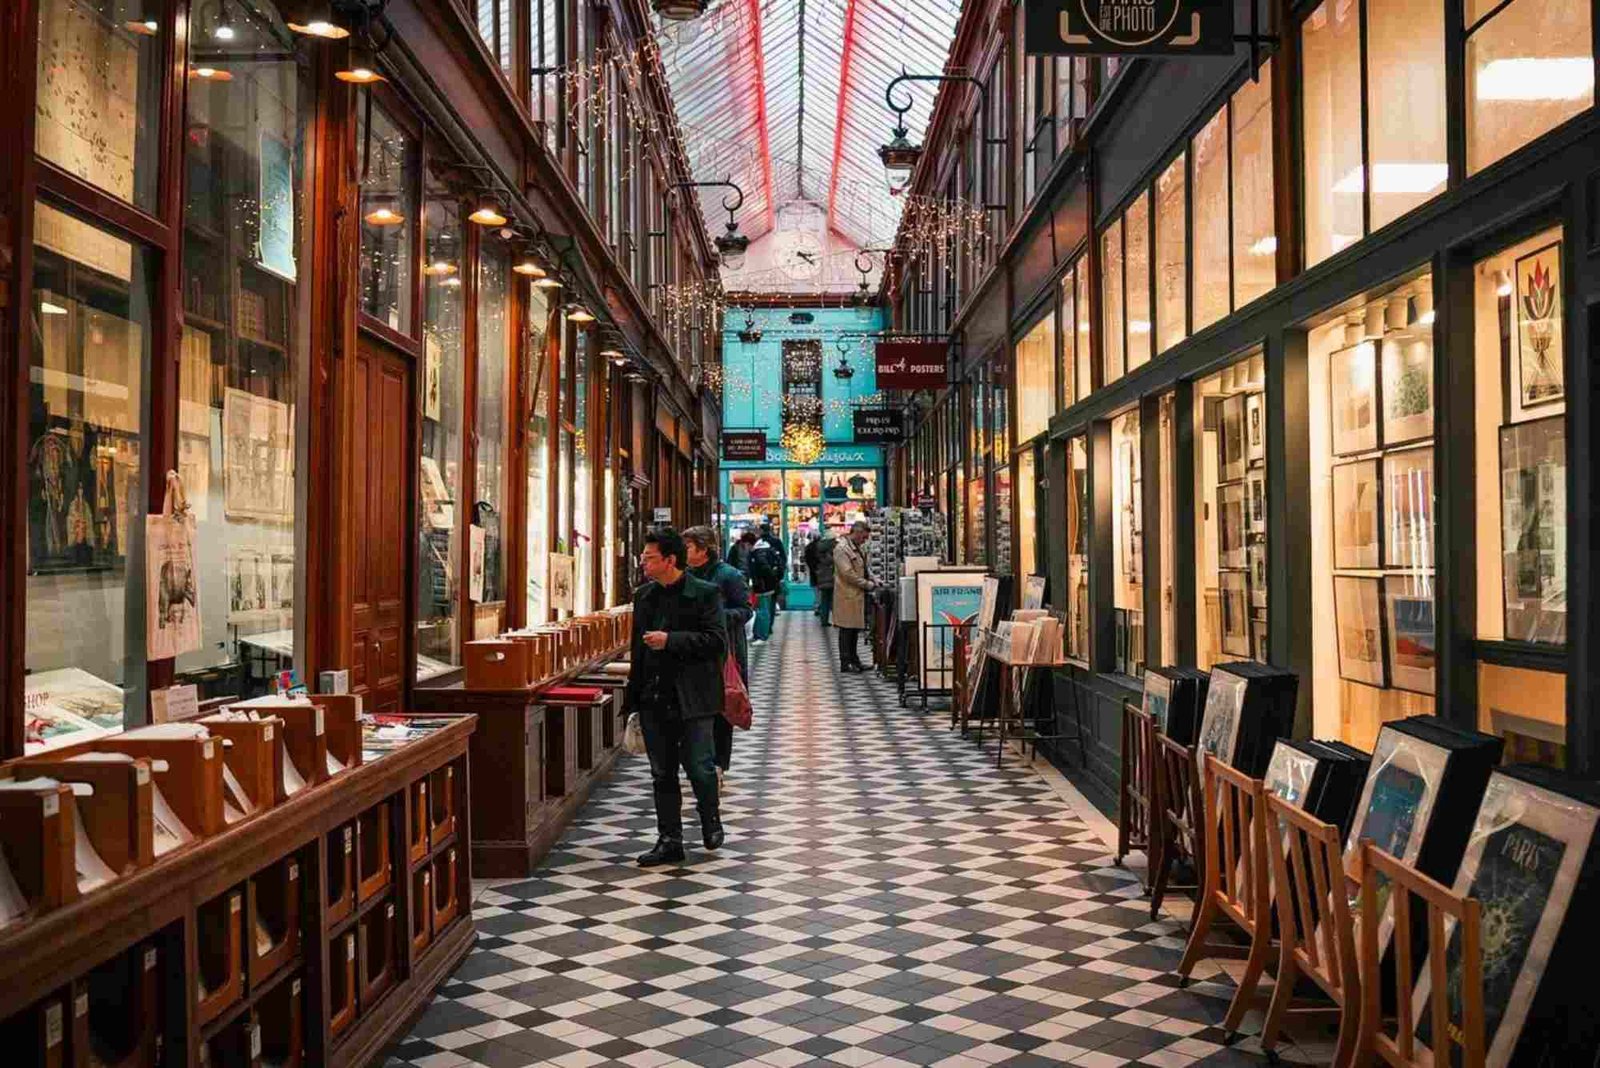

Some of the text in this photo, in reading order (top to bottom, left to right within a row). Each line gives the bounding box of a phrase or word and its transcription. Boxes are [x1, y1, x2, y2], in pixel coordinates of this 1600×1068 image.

[1113, 6, 1155, 31] PHOTO
[878, 364, 945, 373] BILL POSTERS
[1501, 832, 1546, 871] PARIS
